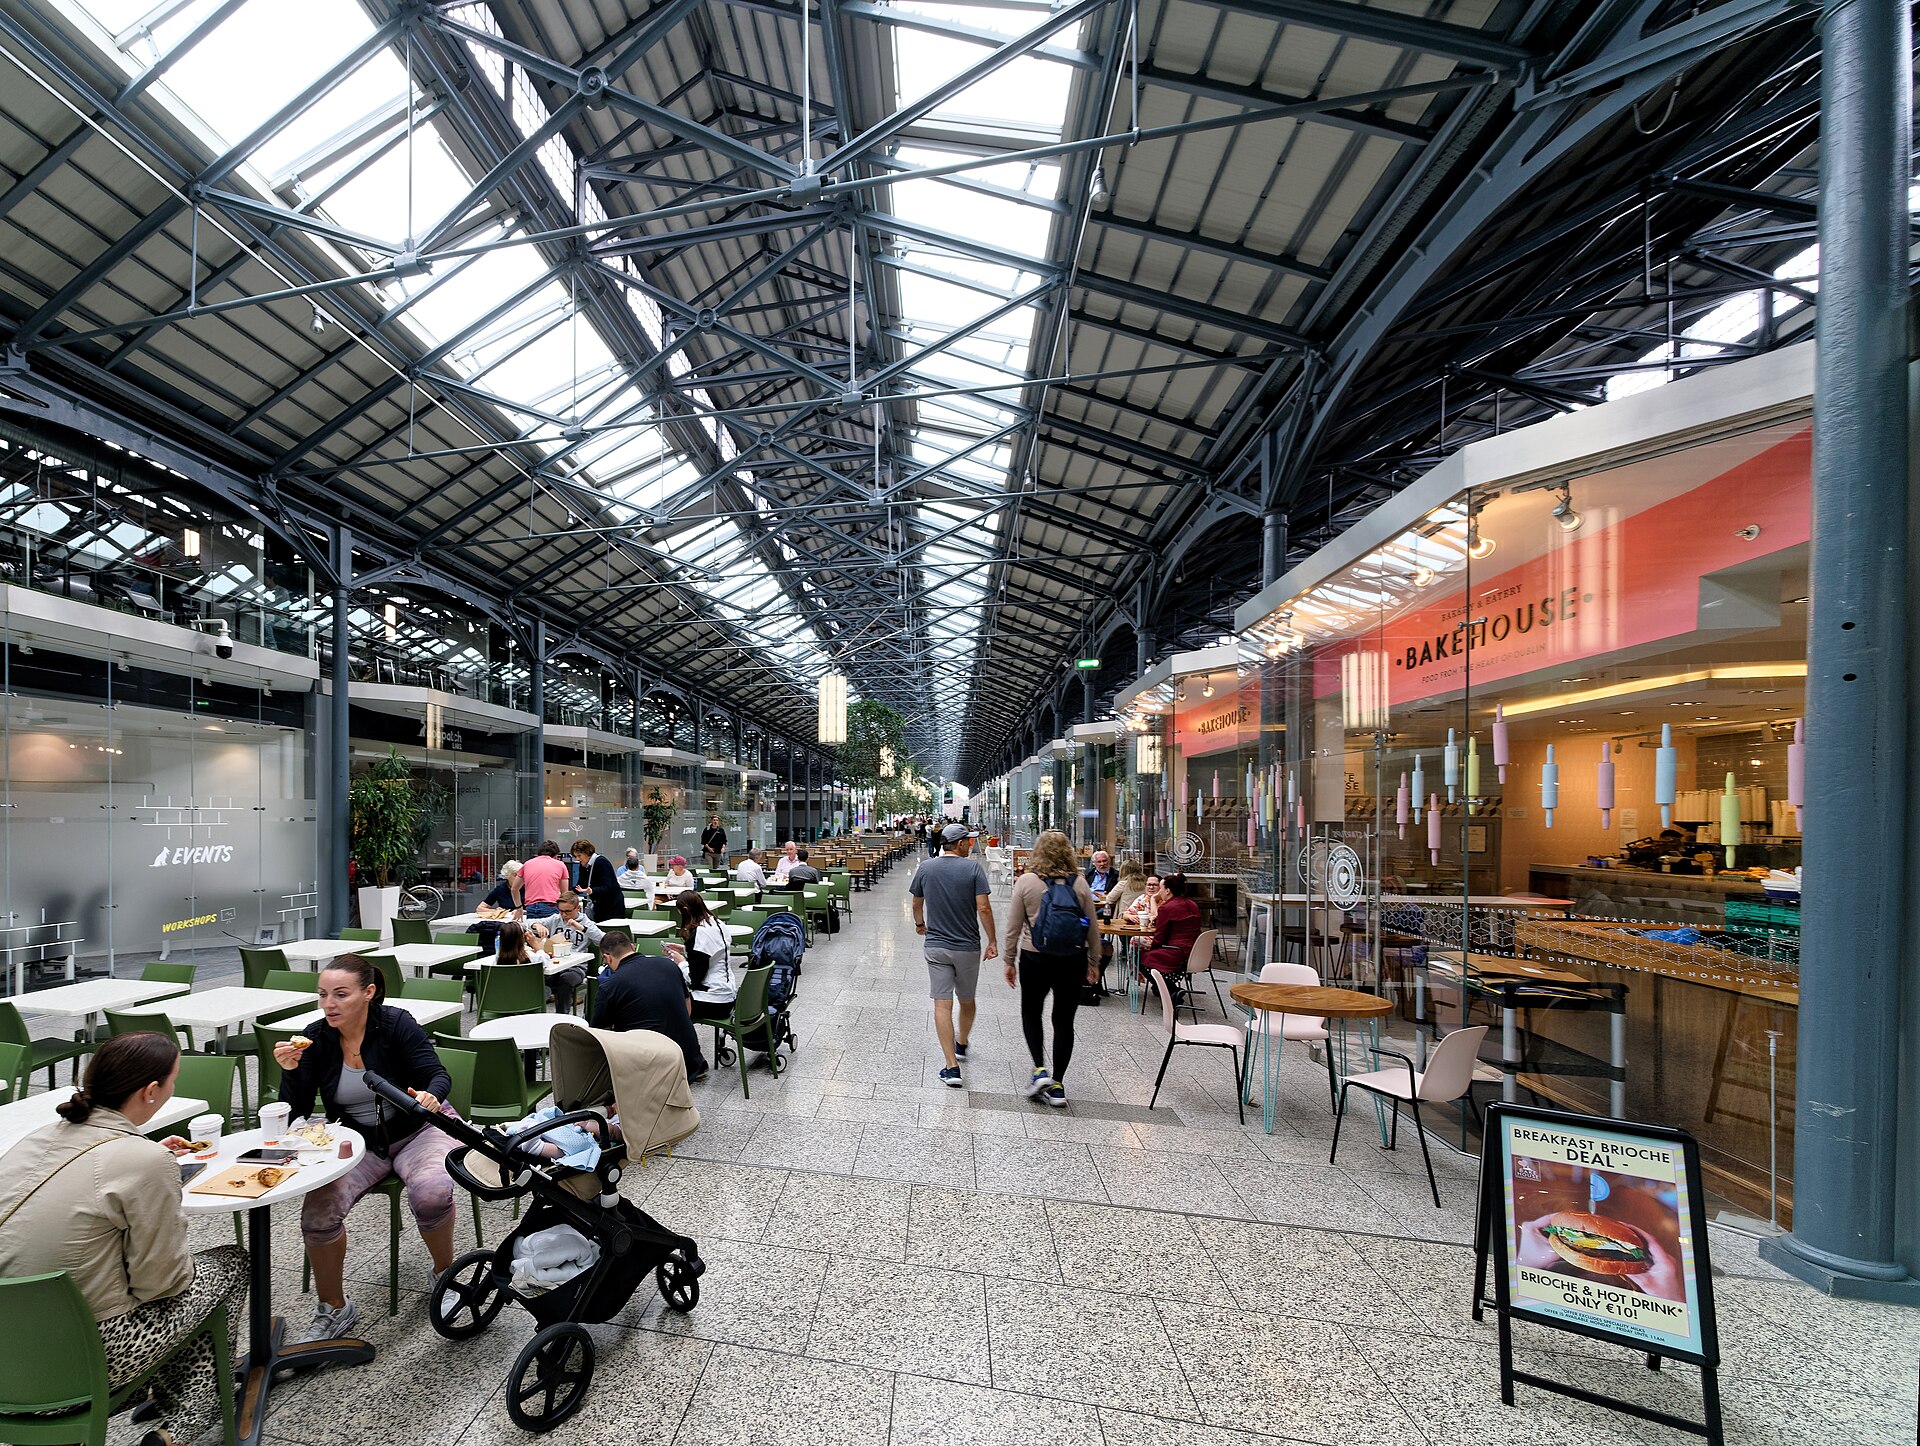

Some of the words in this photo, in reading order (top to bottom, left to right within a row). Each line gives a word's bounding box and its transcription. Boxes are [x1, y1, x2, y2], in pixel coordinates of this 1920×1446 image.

[1486, 584, 1523, 606] EATERY
[1406, 586, 1577, 670] BAKEHOUSE
[1422, 673, 1439, 684] FOOD
[1440, 668, 1458, 679] FROM
[1476, 657, 1499, 669] HEART
[1201, 706, 1247, 735] BAKEHOUSE
[171, 845, 234, 865] EVENTS
[162, 913, 217, 933] WORKSHOPS
[1475, 907, 1527, 916] BULGING
[1536, 911, 1576, 919] BAKED
[1585, 915, 1655, 925] POTATOES
[1667, 920, 1721, 930] YUMMY
[1475, 948, 1541, 960] DELICIOUS
[1548, 956, 1597, 966] DUBLIN
[1606, 962, 1677, 975] CLASSICS
[1688, 971, 1781, 987] HOMEMADE
[1513, 1128, 1595, 1150] BREAKFAST
[1600, 1143, 1670, 1164] BRIOCHE
[1566, 1149, 1615, 1168] DEAL
[1521, 1270, 1578, 1293] BRIOCHE
[1582, 1285, 1593, 1297] &
[1597, 1288, 1627, 1305] HOT
[1563, 1292, 1601, 1310] ONLY
[1606, 1303, 1638, 1320] €10!
